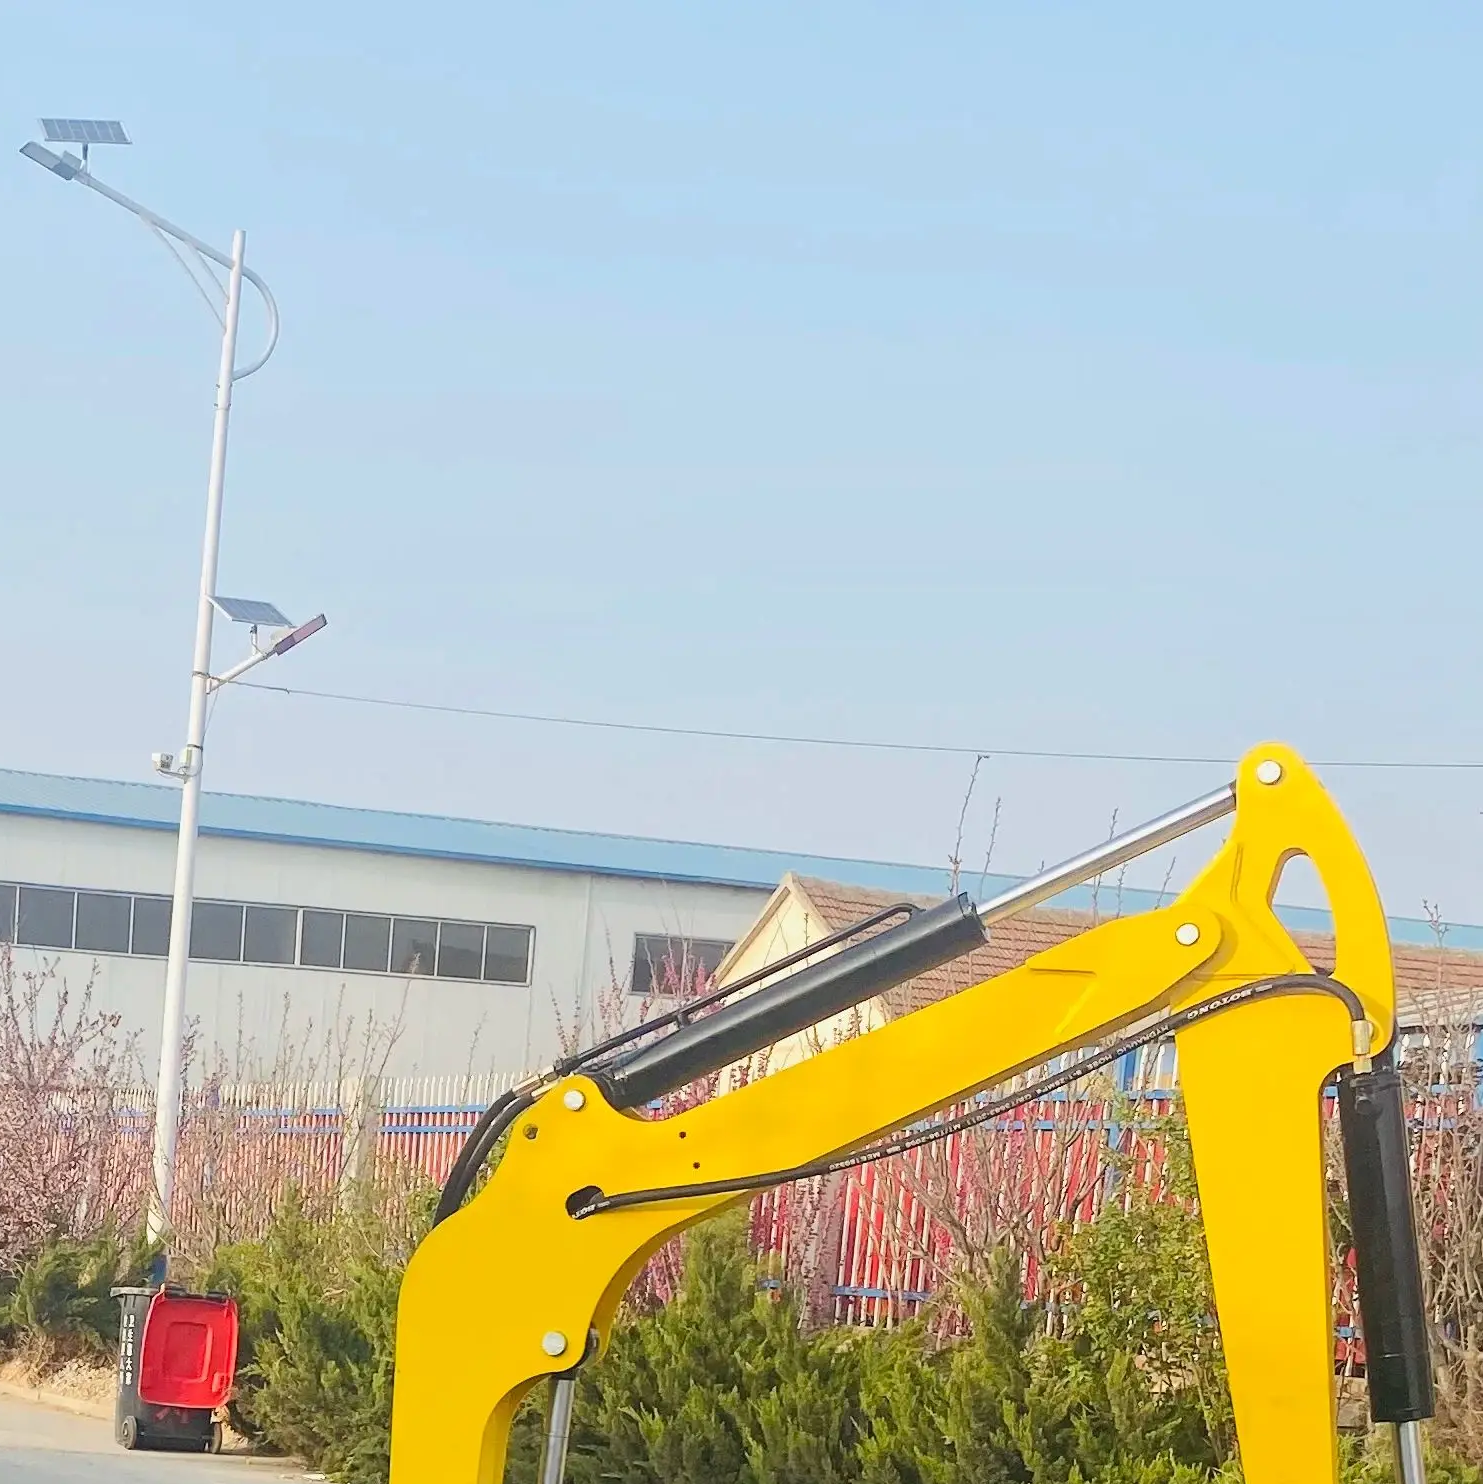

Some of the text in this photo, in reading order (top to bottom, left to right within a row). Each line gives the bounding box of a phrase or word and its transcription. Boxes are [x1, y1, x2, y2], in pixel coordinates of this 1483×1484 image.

[1187, 988, 1252, 1019] BOTONG
[1117, 1024, 1169, 1055] HYDRAULIC
[1087, 1054, 1113, 1071] HOSE
